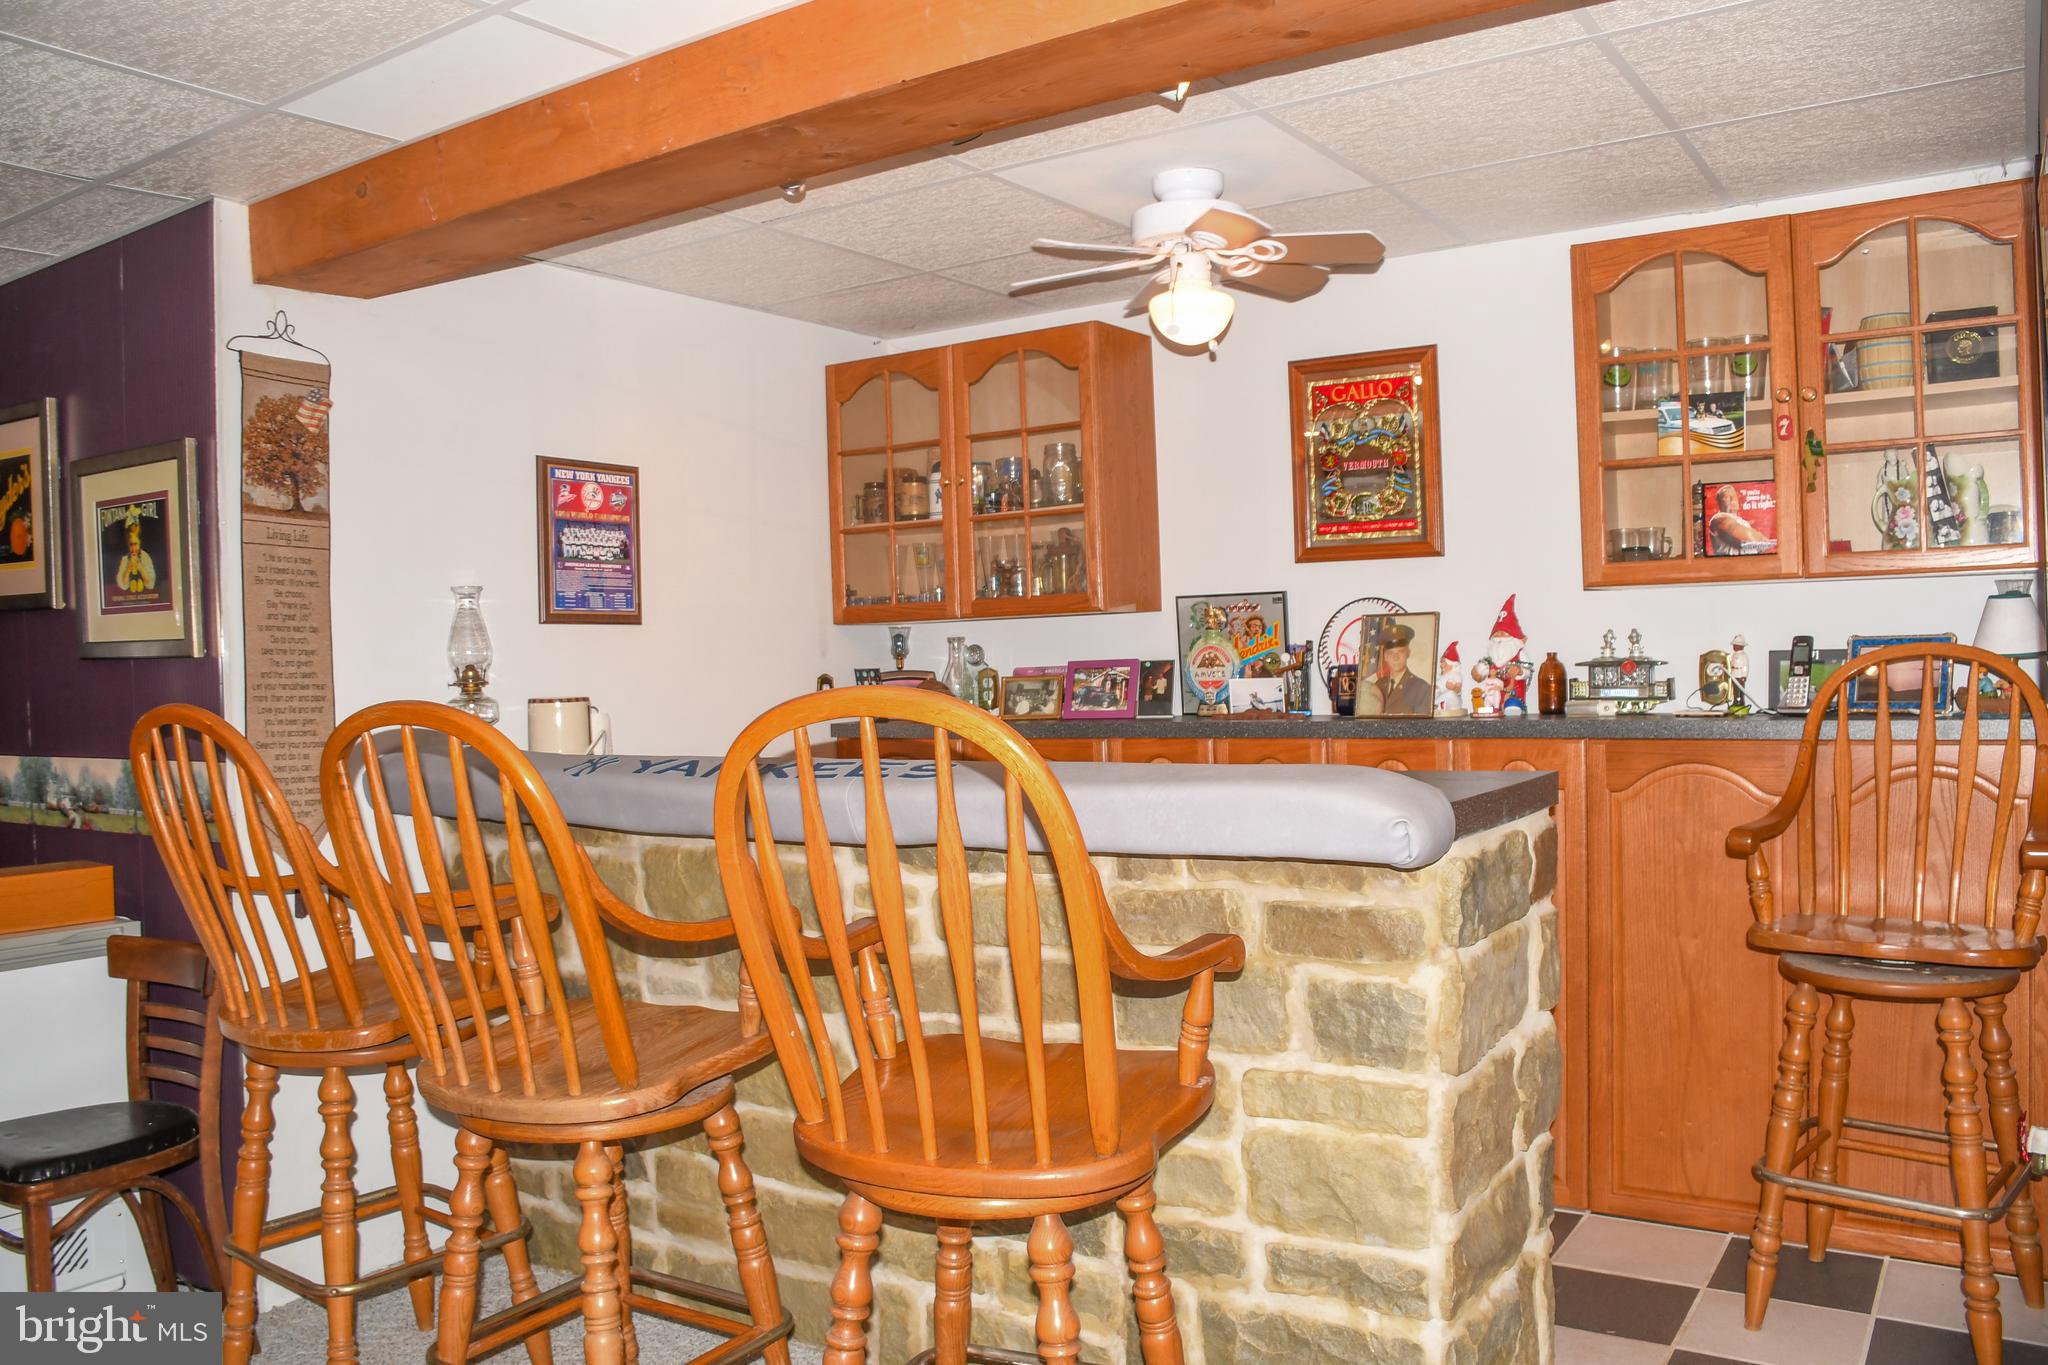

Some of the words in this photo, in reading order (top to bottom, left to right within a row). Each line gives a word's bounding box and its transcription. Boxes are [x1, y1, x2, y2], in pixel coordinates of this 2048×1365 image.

[1331, 381, 1393, 403] GALLO
[1778, 418, 1790, 436] 7
[1343, 457, 1390, 472] VERMOUTH
[555, 468, 574, 479] NEW
[575, 471, 596, 482] YORK
[596, 473, 630, 485] YANKEES
[1743, 501, 1751, 510] do
[266, 527, 292, 544] Living
[293, 529, 309, 543] Life
[1499, 611, 1508, 622] P
